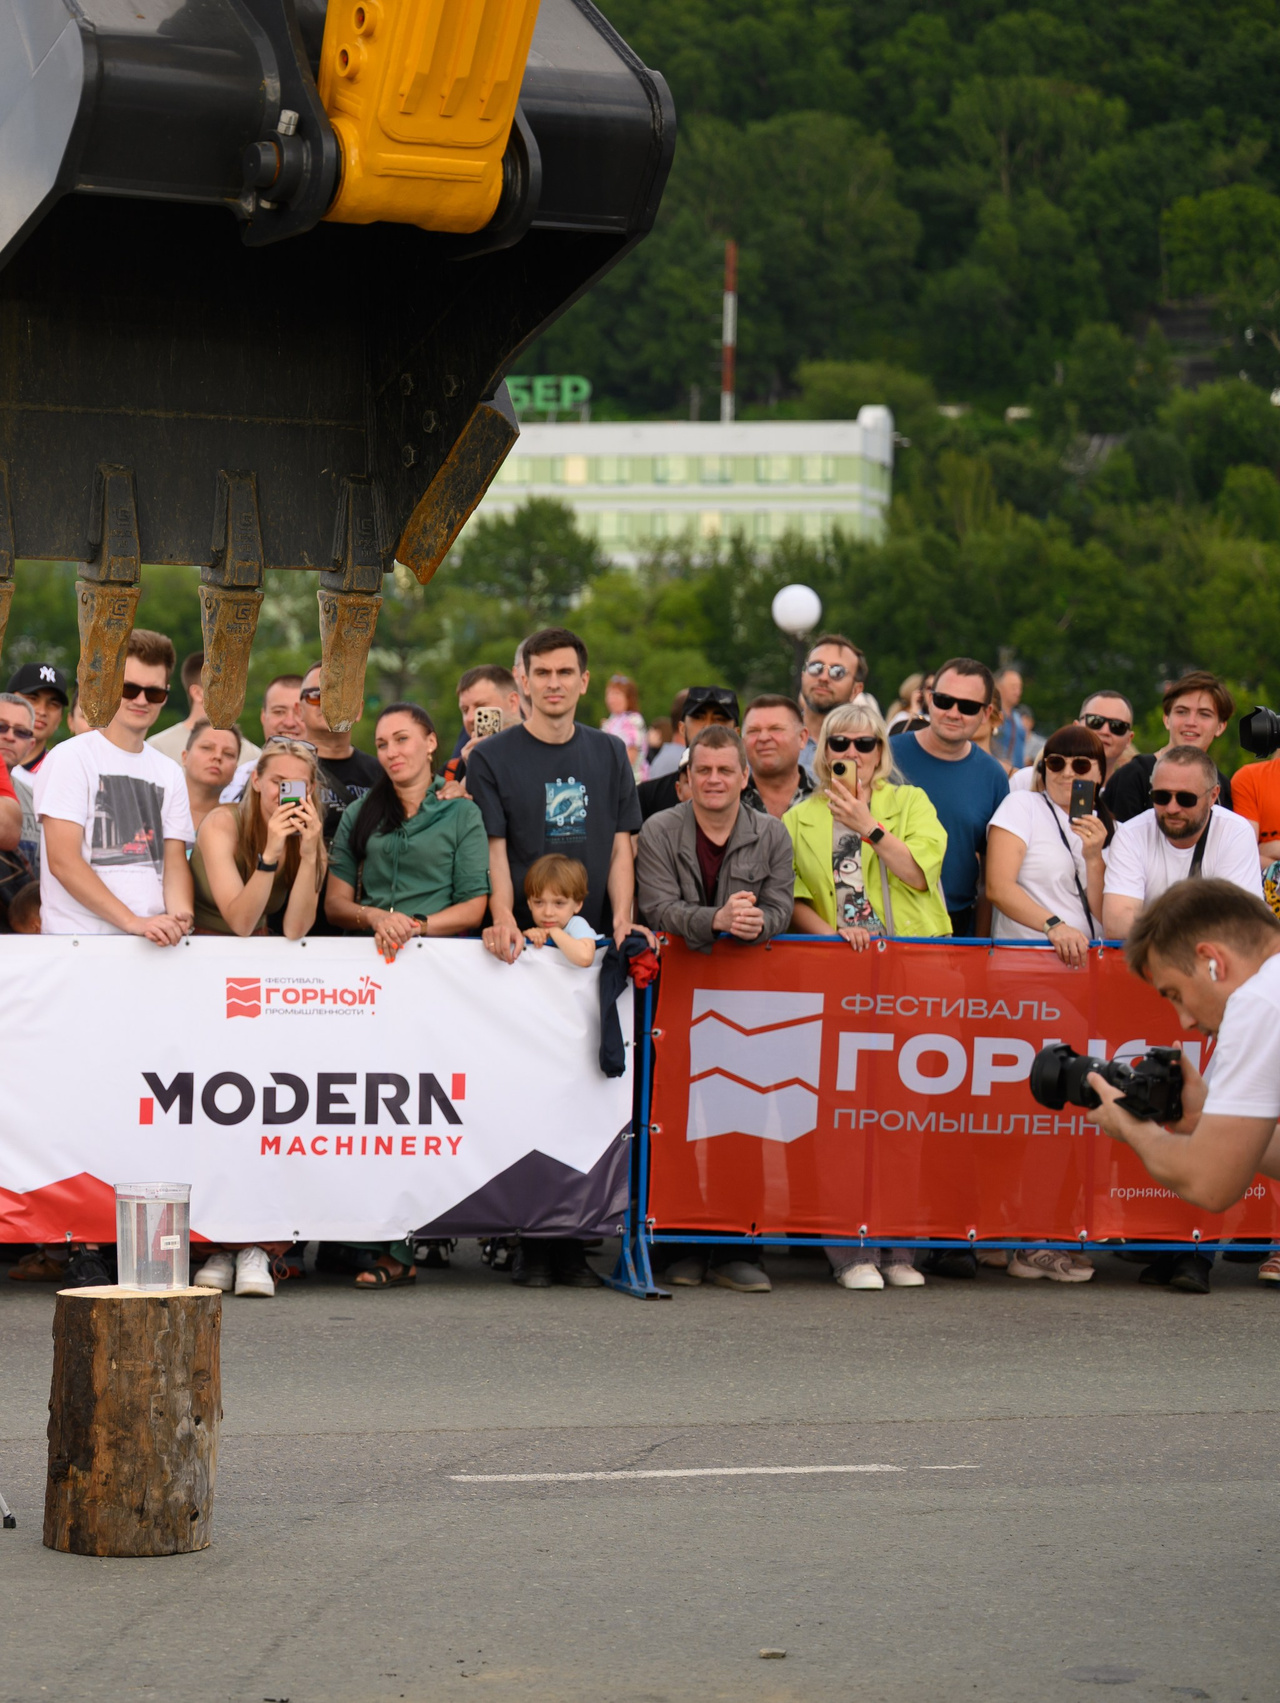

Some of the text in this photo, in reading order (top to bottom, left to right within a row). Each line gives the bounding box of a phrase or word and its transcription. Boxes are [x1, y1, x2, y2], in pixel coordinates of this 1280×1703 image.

[265, 976, 382, 1006] ГОРНОЙ
[841, 993, 1061, 1021] ФЕСТИВАЛЬ
[139, 1071, 466, 1126] MODERN
[833, 1108, 1101, 1136] ПРОМЫШЛЕНН
[260, 1135, 463, 1156] MACHINERY
